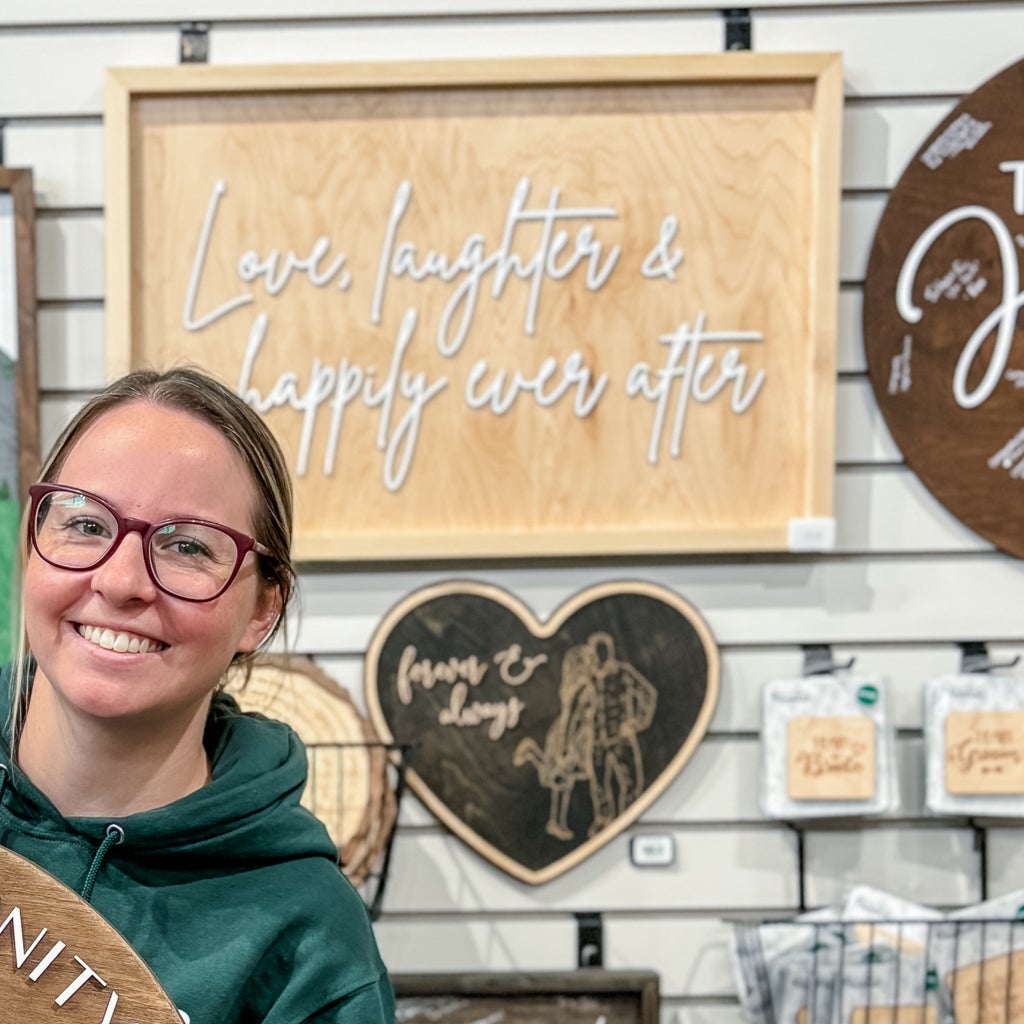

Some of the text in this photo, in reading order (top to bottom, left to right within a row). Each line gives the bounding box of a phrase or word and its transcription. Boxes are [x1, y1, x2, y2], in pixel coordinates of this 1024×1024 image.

[183, 176, 687, 357] Love, laughter &
[238, 306, 766, 493] happily ever after
